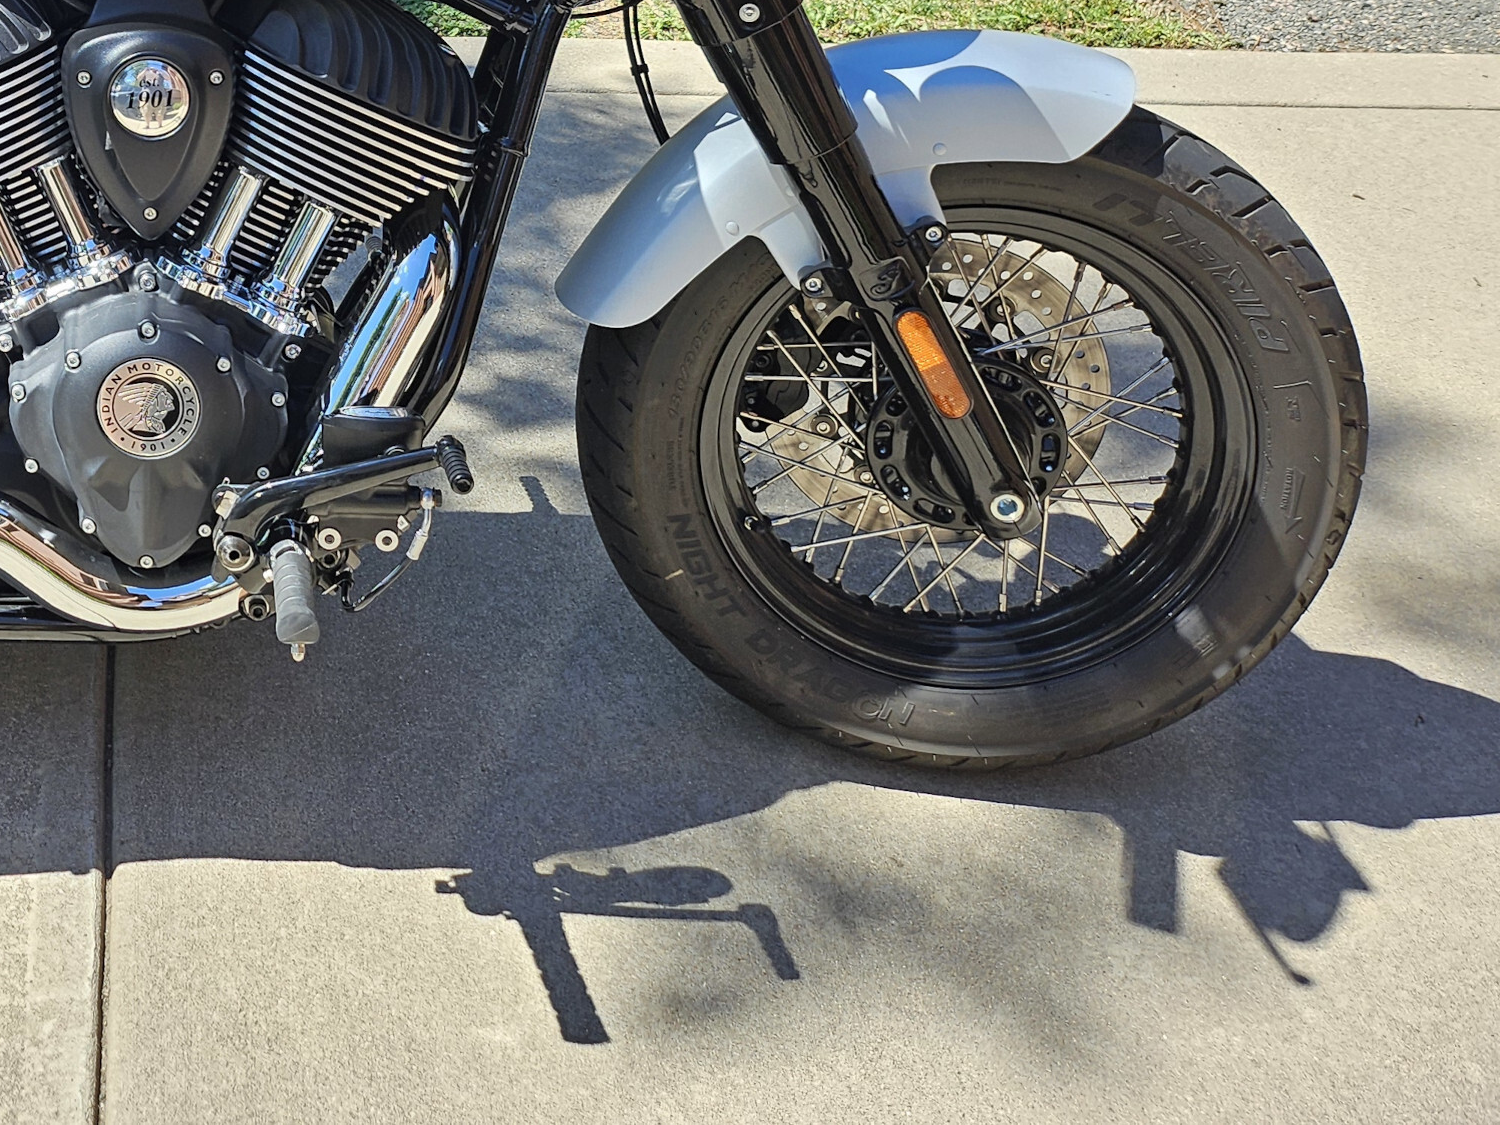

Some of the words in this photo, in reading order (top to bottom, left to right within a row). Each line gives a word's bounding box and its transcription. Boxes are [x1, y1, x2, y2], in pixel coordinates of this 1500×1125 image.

[127, 90, 173, 109] 1901
[138, 78, 160, 87] est.
[1092, 193, 1291, 354] PIRELLI
[102, 373, 122, 435] INDIAN
[128, 363, 195, 435] MOTORCYCLE
[131, 440, 166, 452] 1901
[1280, 467, 1293, 511] ROTATION
[666, 513, 747, 618] NIGHT
[744, 628, 916, 727] DRAGON
